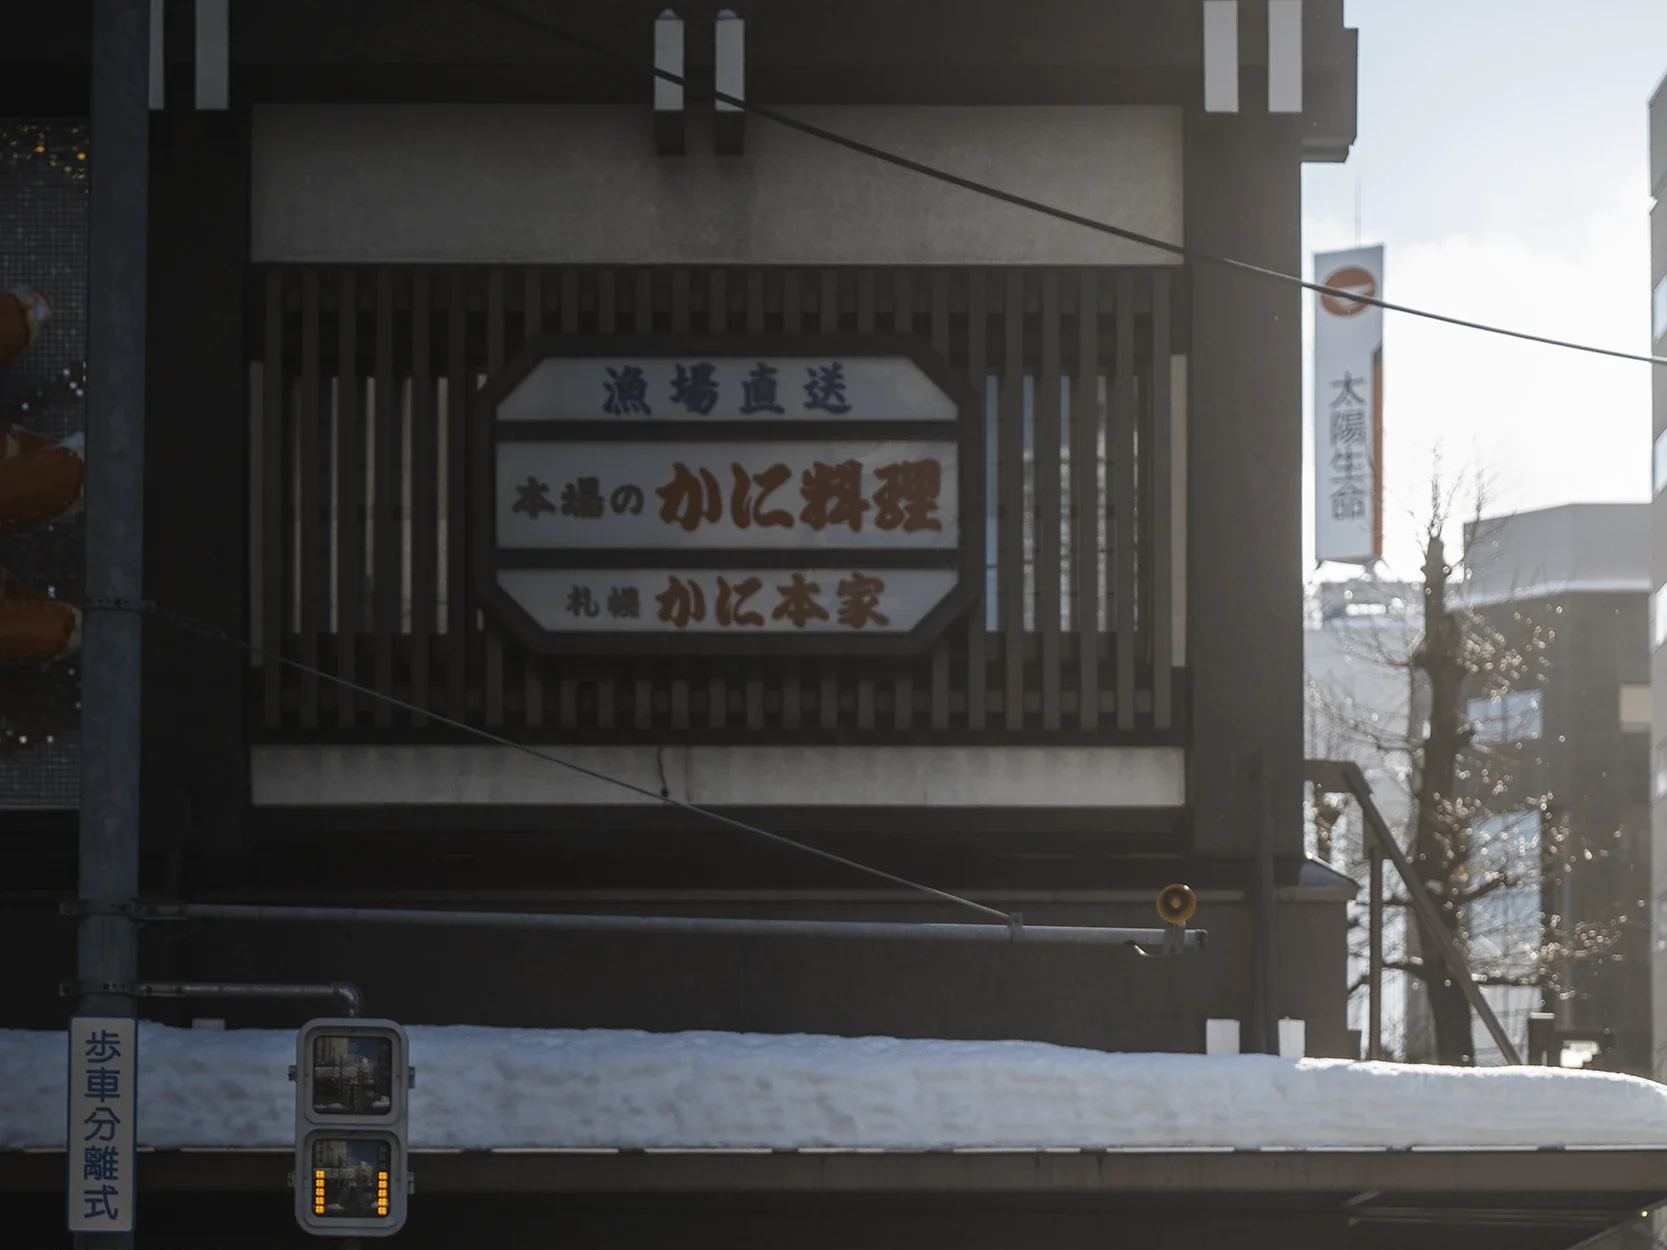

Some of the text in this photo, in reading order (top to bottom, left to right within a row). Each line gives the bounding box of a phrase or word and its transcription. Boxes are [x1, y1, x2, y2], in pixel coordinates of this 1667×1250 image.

[602, 362, 851, 416] 漁場直送
[1329, 370, 1367, 521] 太陽生命
[512, 458, 942, 533] 本場のかに料理
[83, 1029, 121, 1220] 歩車分離式
